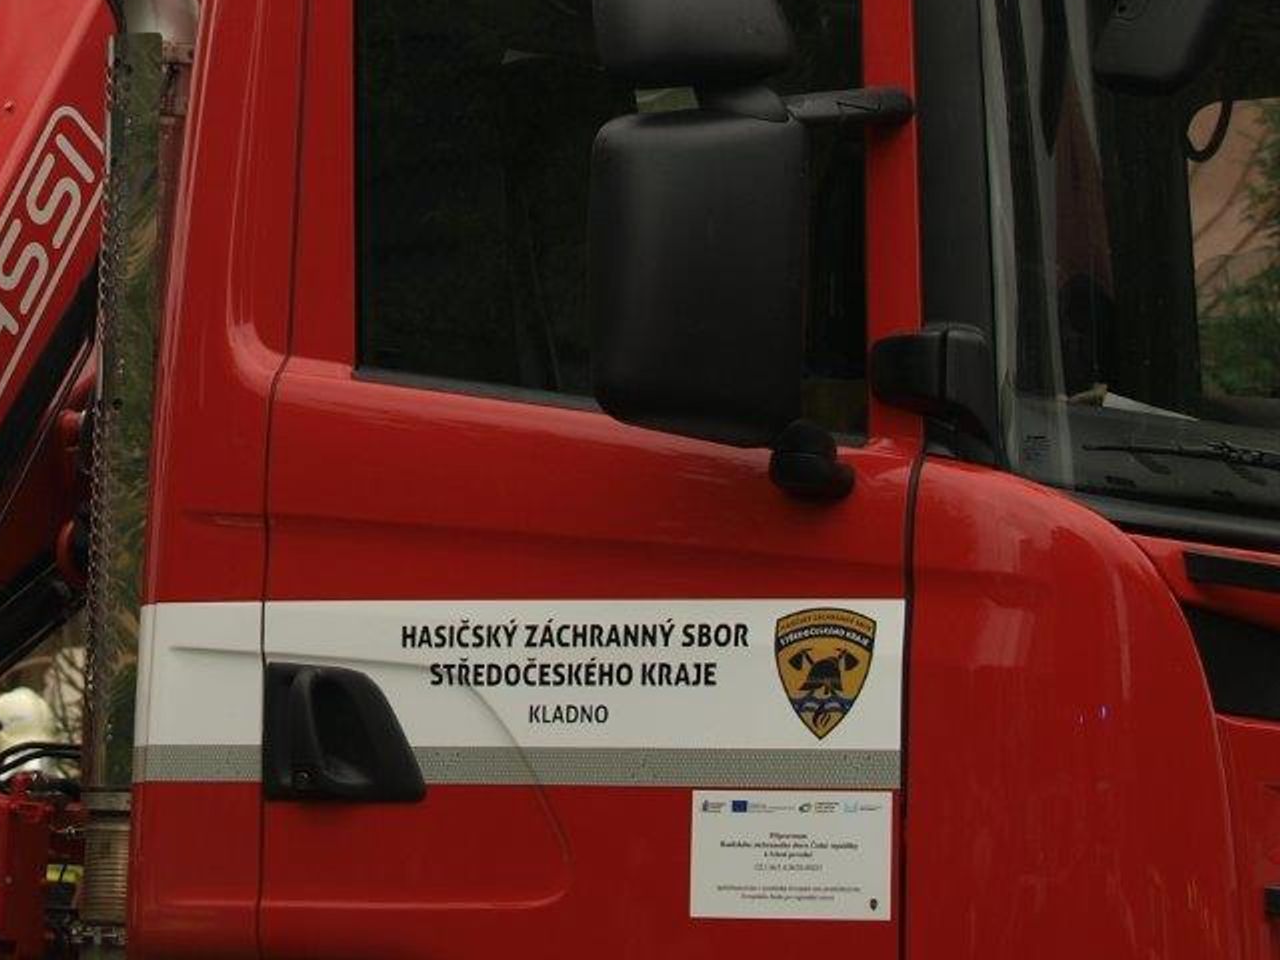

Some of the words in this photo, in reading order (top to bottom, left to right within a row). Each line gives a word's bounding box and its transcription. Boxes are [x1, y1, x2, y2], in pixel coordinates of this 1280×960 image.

[401, 619, 518, 648] HASIČSKÝ
[524, 619, 676, 648] ZÁCHRANNÝ
[681, 623, 750, 648] SBOR
[429, 657, 634, 687] STŘEDOČESKÉHO
[640, 662, 718, 687] KRAJE
[528, 704, 609, 724] KLADNO
